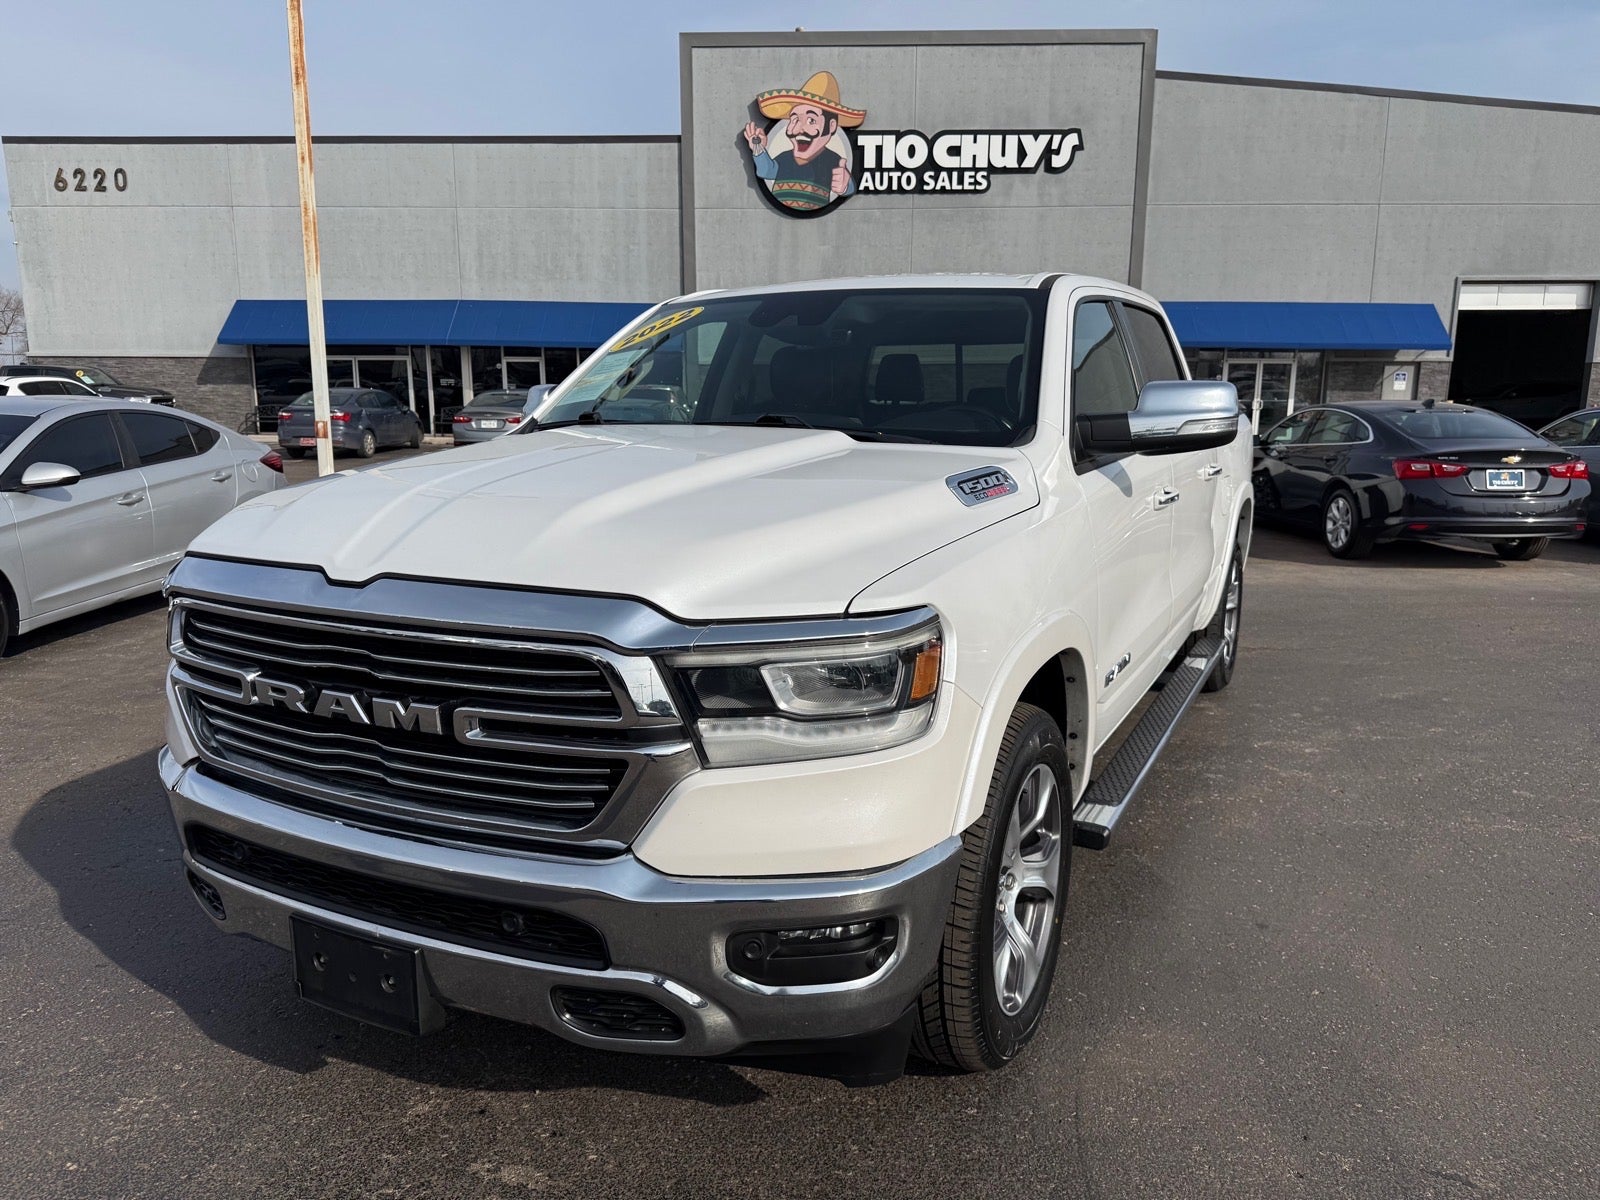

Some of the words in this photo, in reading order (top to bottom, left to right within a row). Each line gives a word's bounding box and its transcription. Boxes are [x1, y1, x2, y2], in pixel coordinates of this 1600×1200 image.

[857, 133, 929, 169] TIO
[932, 132, 1080, 169] CHUY'S
[53, 167, 128, 192] 6220
[858, 171, 917, 191] AUTO
[923, 170, 989, 191] SALES
[619, 308, 696, 348] 2022
[960, 473, 1004, 494] 1500
[254, 676, 445, 735] RAM
